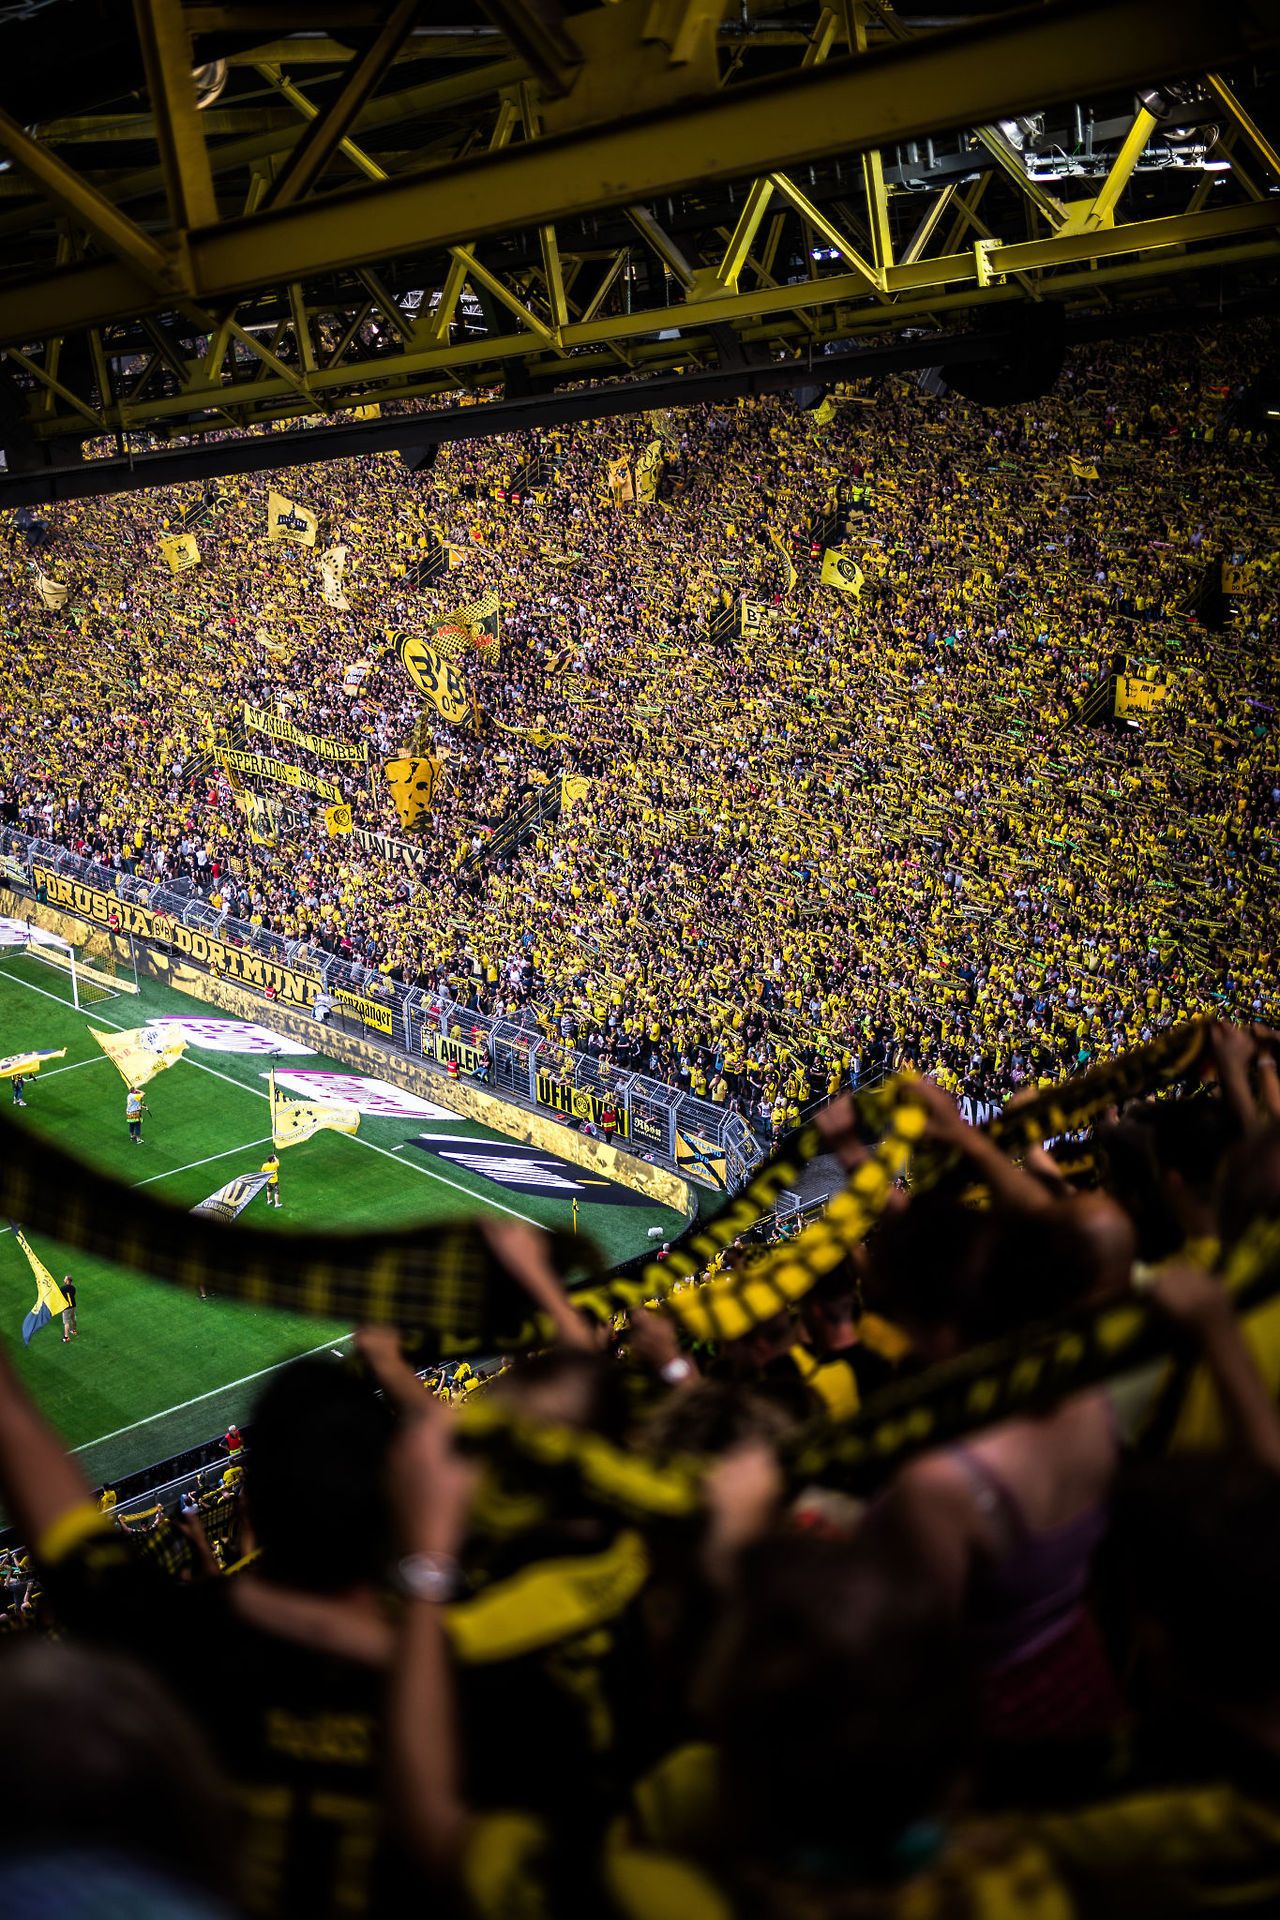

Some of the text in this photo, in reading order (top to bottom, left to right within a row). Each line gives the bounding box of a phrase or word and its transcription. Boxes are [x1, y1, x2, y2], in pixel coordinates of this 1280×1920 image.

[409, 643, 467, 705] BVB
[441, 695, 458, 715] 09
[312, 736, 365, 760] BLEIBEN
[33, 866, 152, 936] BORUSSIA
[174, 923, 325, 1006] DORTMUND
[440, 1039, 483, 1072] AHLEN
[632, 1116, 662, 1137] Rhön
[682, 1133, 723, 1158] SCOTLAND
[694, 1151, 710, 1164] BVB
